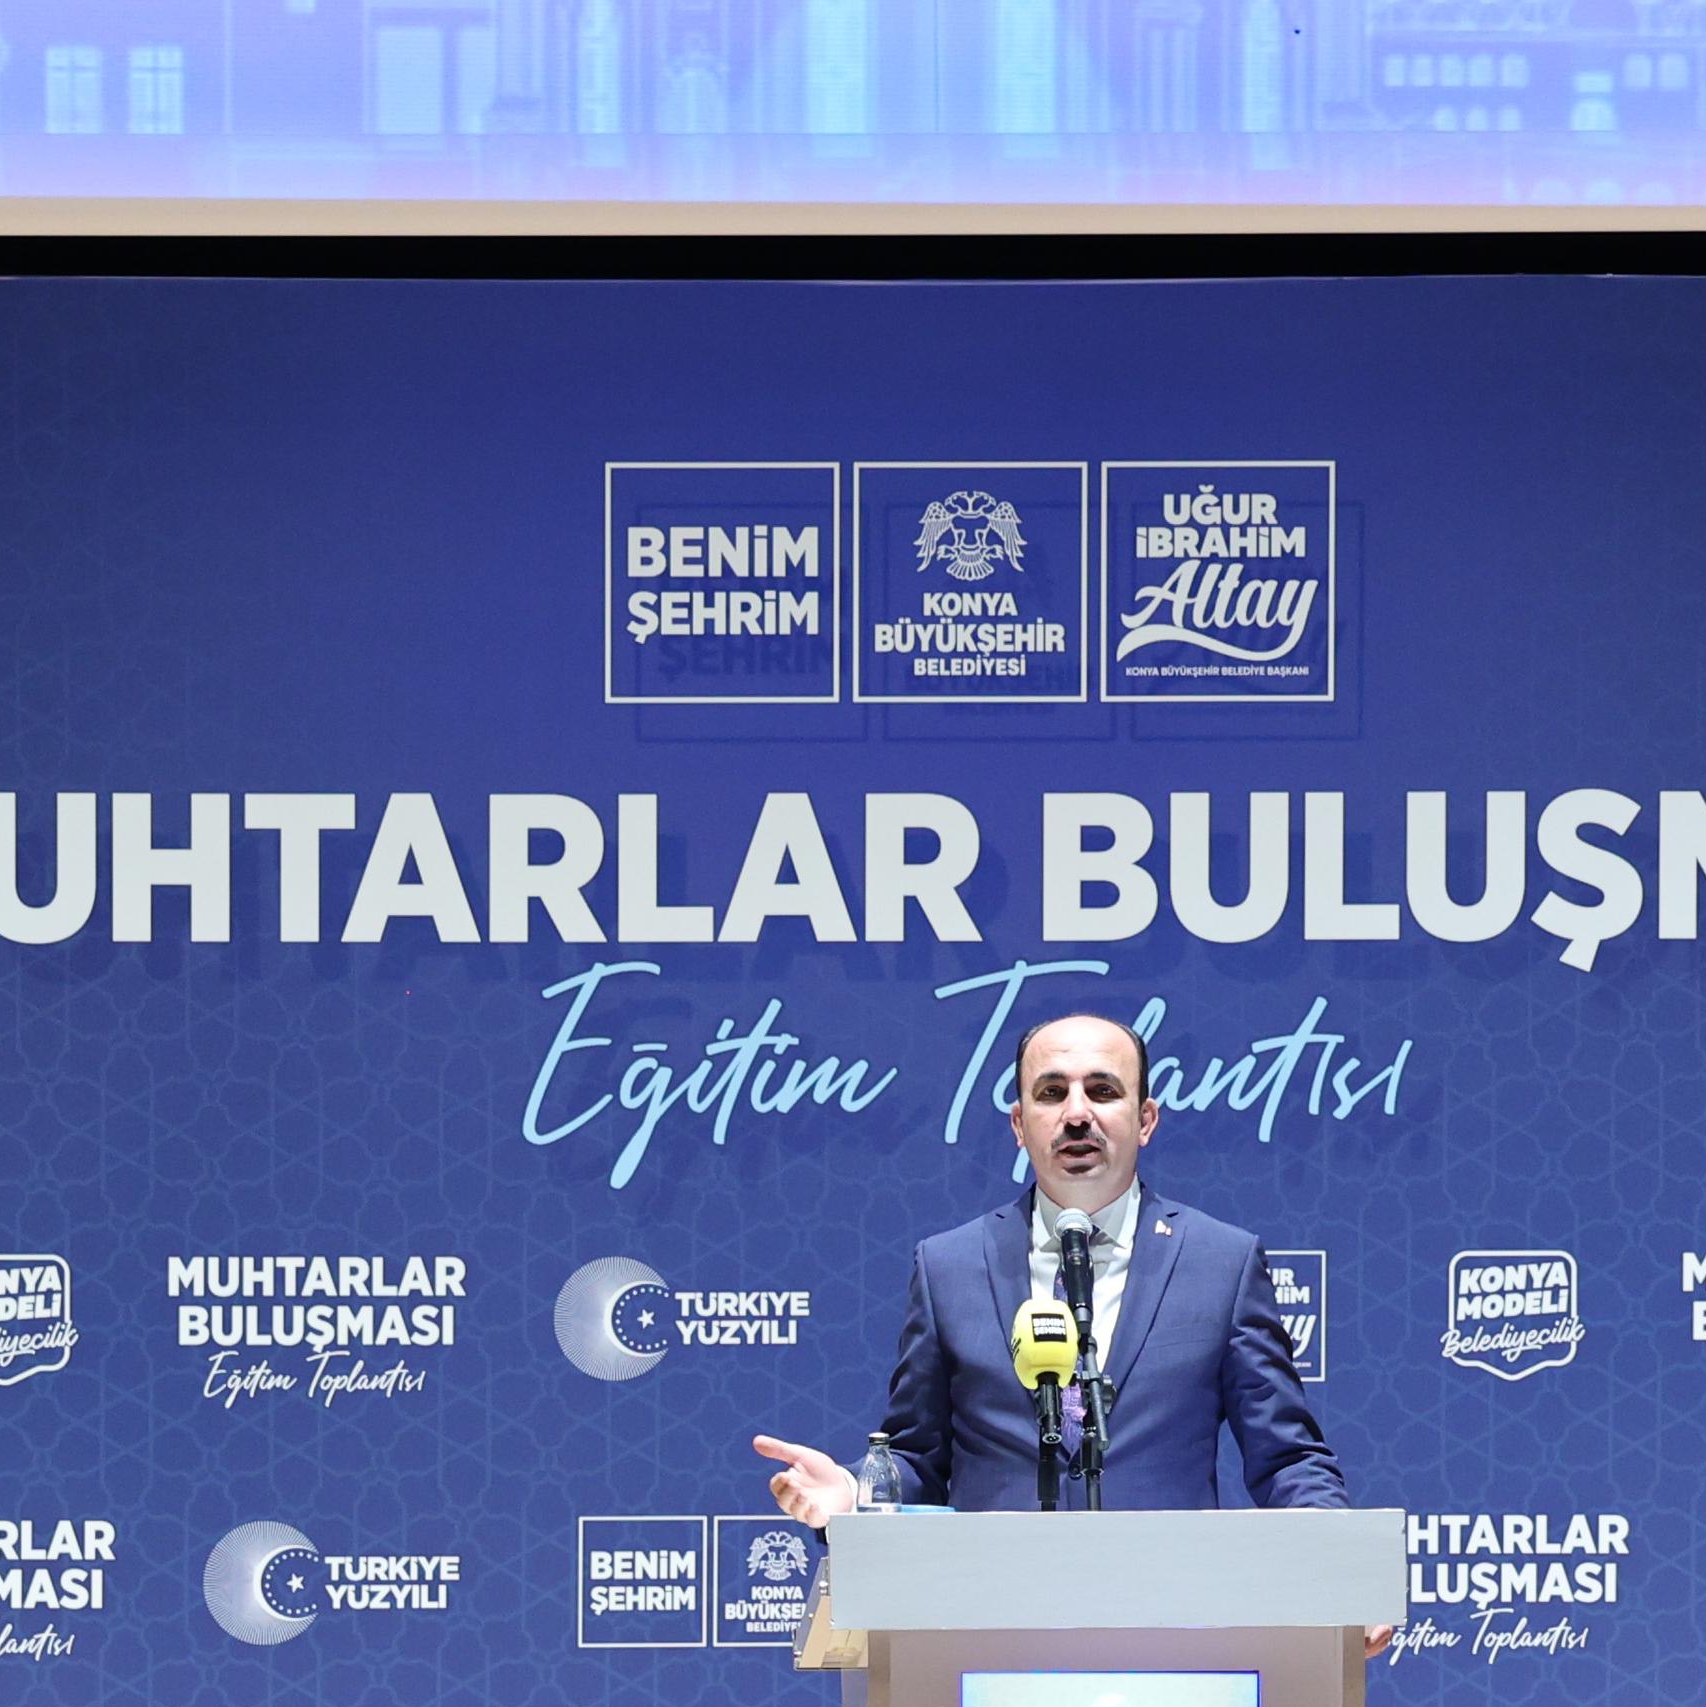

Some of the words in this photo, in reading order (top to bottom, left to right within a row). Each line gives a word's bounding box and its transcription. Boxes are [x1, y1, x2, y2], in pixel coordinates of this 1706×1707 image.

[1164, 485, 1278, 526] UĞUR
[628, 526, 819, 577] BENİM
[1137, 526, 1306, 558] İBRAHİM
[627, 591, 819, 645] ŞEHRİM
[924, 592, 1018, 617] KONYA
[1117, 560, 1319, 662] Altay
[875, 618, 1065, 657] BÜYÜKŞEHİR
[913, 654, 1026, 676] BELEDİYESİ
[1125, 666, 1160, 677] KONYA
[1161, 664, 1220, 678] BÜYÜKŞEHİR
[1221, 664, 1265, 677] BELEDİYE
[1267, 666, 1309, 678] BAŞKANI
[521, 961, 898, 1190] Eğitim
[169, 1257, 466, 1298] MUHTARLAR
[1458, 1263, 1569, 1295] KONYA
[1456, 1290, 1569, 1321] MODELİ
[179, 1306, 454, 1354] BULUŞMASI
[1441, 1316, 1586, 1364] Belediyecilik
[205, 1350, 298, 1409] Eğitim
[306, 1350, 427, 1408] Toplantısı
[1407, 1514, 1630, 1555] HTARLAR
[590, 1550, 696, 1580] BENİM
[590, 1585, 696, 1616] ŞEHRİM
[1410, 1562, 1618, 1610] LUŞMASI
[1388, 1617, 1462, 1667] ğitim
[1470, 1608, 1589, 1665] Toplantısı
